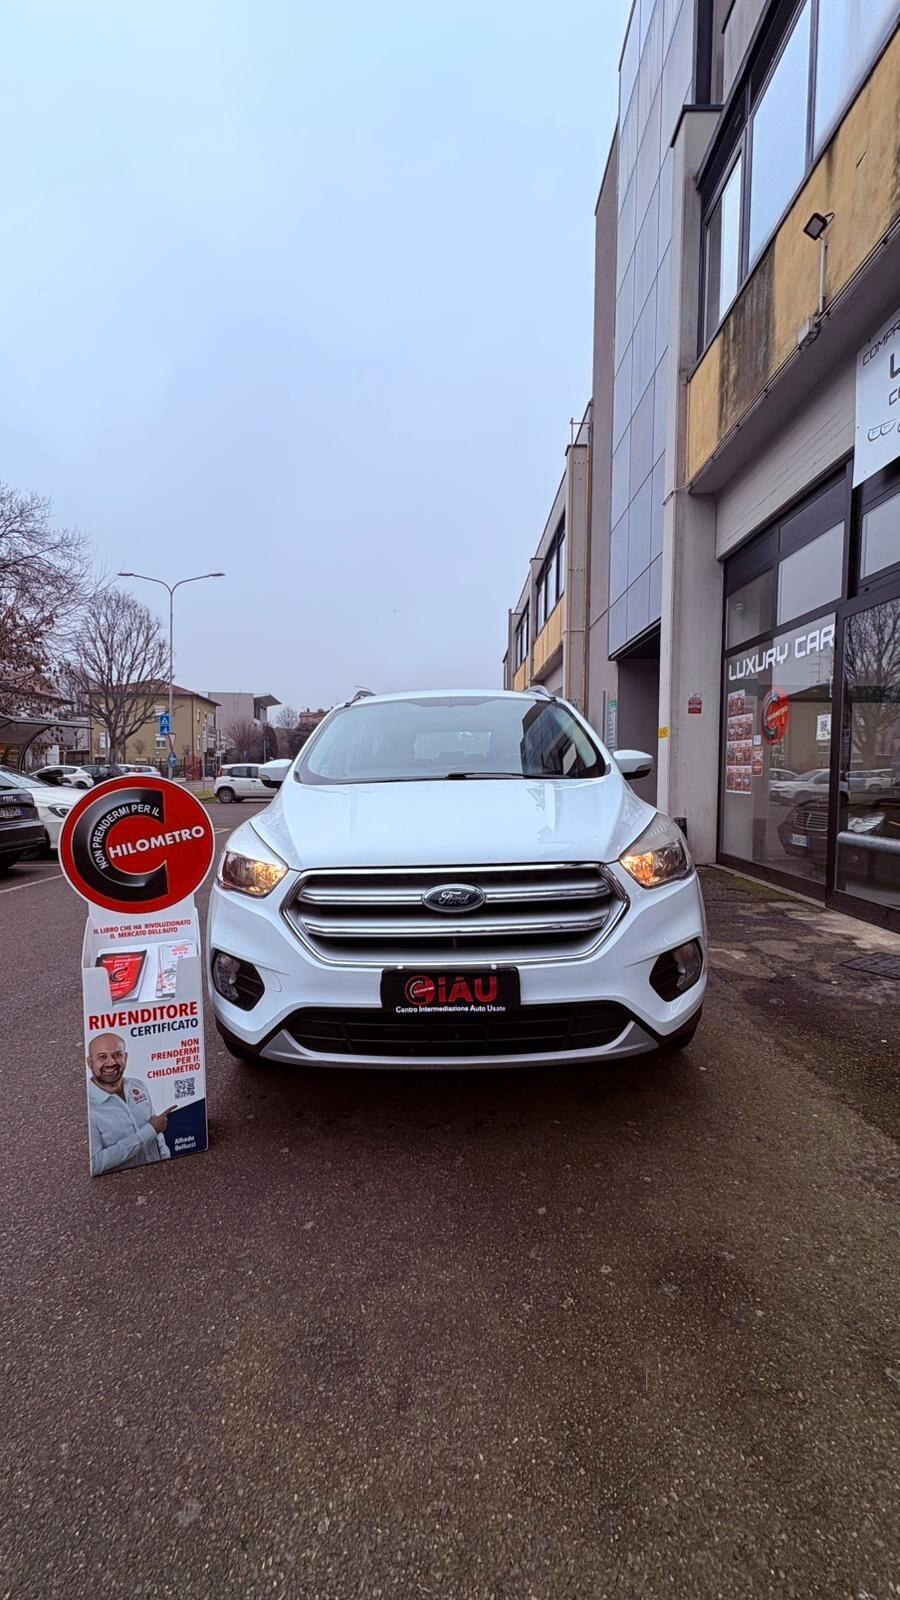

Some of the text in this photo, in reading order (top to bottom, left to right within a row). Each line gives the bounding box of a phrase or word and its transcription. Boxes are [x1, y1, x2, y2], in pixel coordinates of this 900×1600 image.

[728, 623, 835, 681] LUXURY CAR
[93, 804, 160, 869] NON PRENDERMI PER IL
[438, 890, 470, 904] Ford
[100, 926, 119, 934] LIBRO
[144, 919, 191, 929] RIVOLUZIONATO
[118, 930, 147, 938] MERCATO
[88, 1001, 198, 1031] RIVENDITORE
[419, 1005, 469, 1013] Intermediazione
[487, 1004, 506, 1012] Usate
[130, 1018, 199, 1037] CERTIFICATO
[181, 1037, 199, 1047] NON
[151, 1046, 200, 1061] PRENDERMI
[176, 1056, 192, 1065] PER
[147, 1062, 200, 1079] CHILOMETRO
